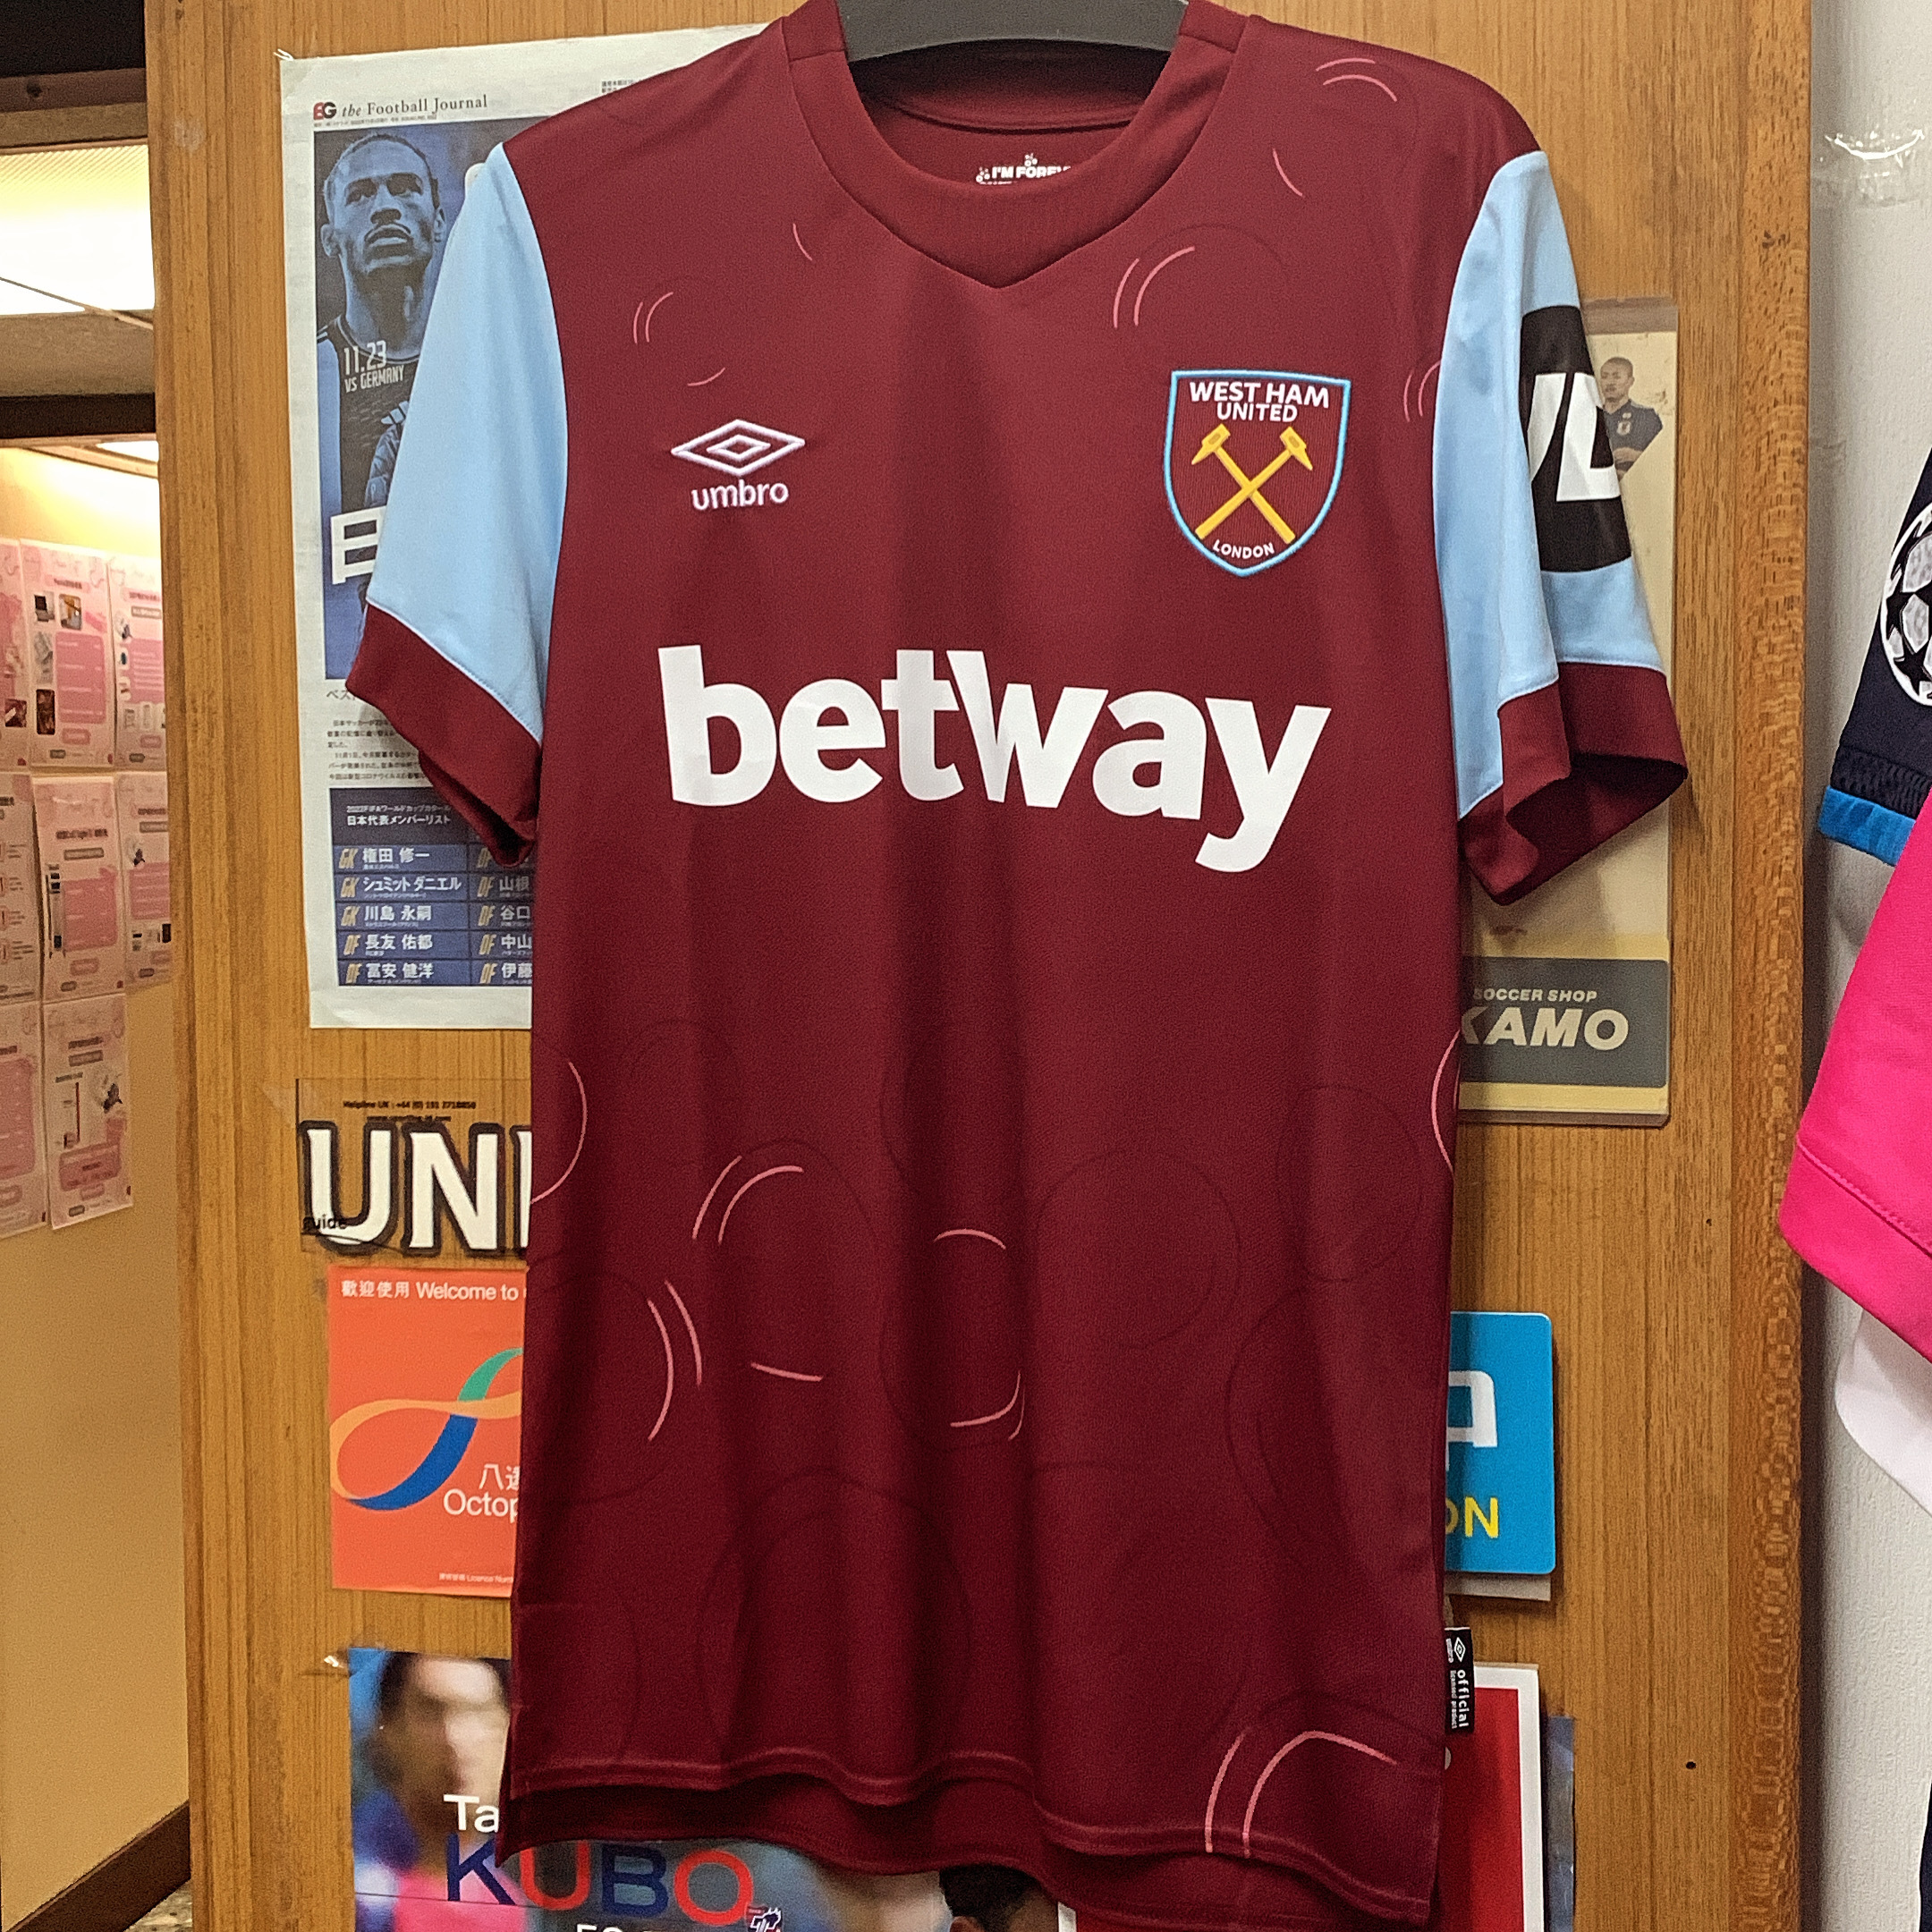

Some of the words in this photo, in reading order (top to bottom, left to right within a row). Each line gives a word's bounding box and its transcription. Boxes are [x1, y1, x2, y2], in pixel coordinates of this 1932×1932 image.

[342, 103, 362, 117] the
[367, 98, 428, 115] Football
[432, 94, 487, 115] Journal
[992, 165, 1014, 179] I'M
[343, 340, 387, 376] 11.23
[344, 377, 358, 393] VS
[360, 365, 404, 390] GERMANY
[1189, 382, 1261, 402] WEST
[1266, 384, 1329, 408] HAM
[1216, 402, 1298, 422] UNITED
[691, 479, 789, 511] umbro
[1212, 539, 1275, 559] LONDON
[657, 644, 1333, 873] betway
[347, 814, 452, 826] 日本代表メンバーリスト
[363, 877, 411, 892] シュミット
[413, 876, 462, 892] ダニエル
[364, 905, 395, 921] 川島
[500, 904, 530, 920] 谷口
[501, 933, 533, 949] 中山
[1473, 988, 1543, 1001] SOCCER
[1547, 989, 1597, 1003] SHOP
[341, 1280, 411, 1297] 歡迎使用
[416, 1282, 496, 1301] Welcome
[500, 1284, 519, 1301] to
[1457, 1669, 1470, 1727] official
[447, 1833, 754, 1927] KUBO
